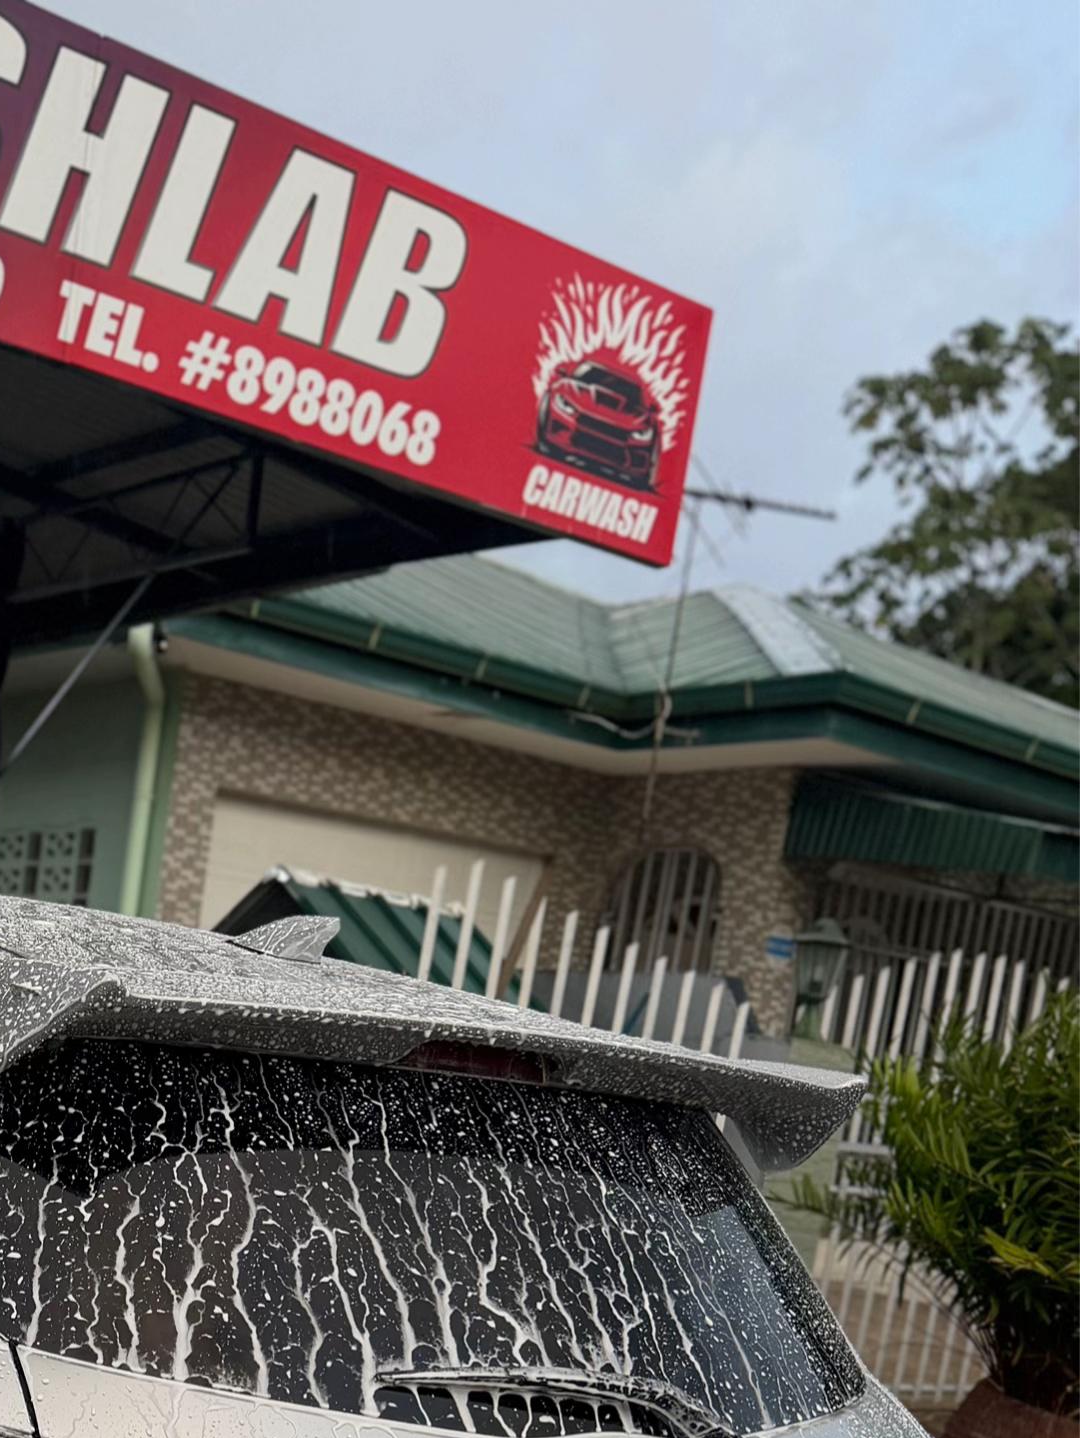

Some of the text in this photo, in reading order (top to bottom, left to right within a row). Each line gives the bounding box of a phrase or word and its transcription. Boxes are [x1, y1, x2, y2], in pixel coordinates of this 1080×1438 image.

[57, 279, 159, 372] TEL.
[178, 331, 441, 465] #8988068
[522, 464, 659, 544] CARWASH
